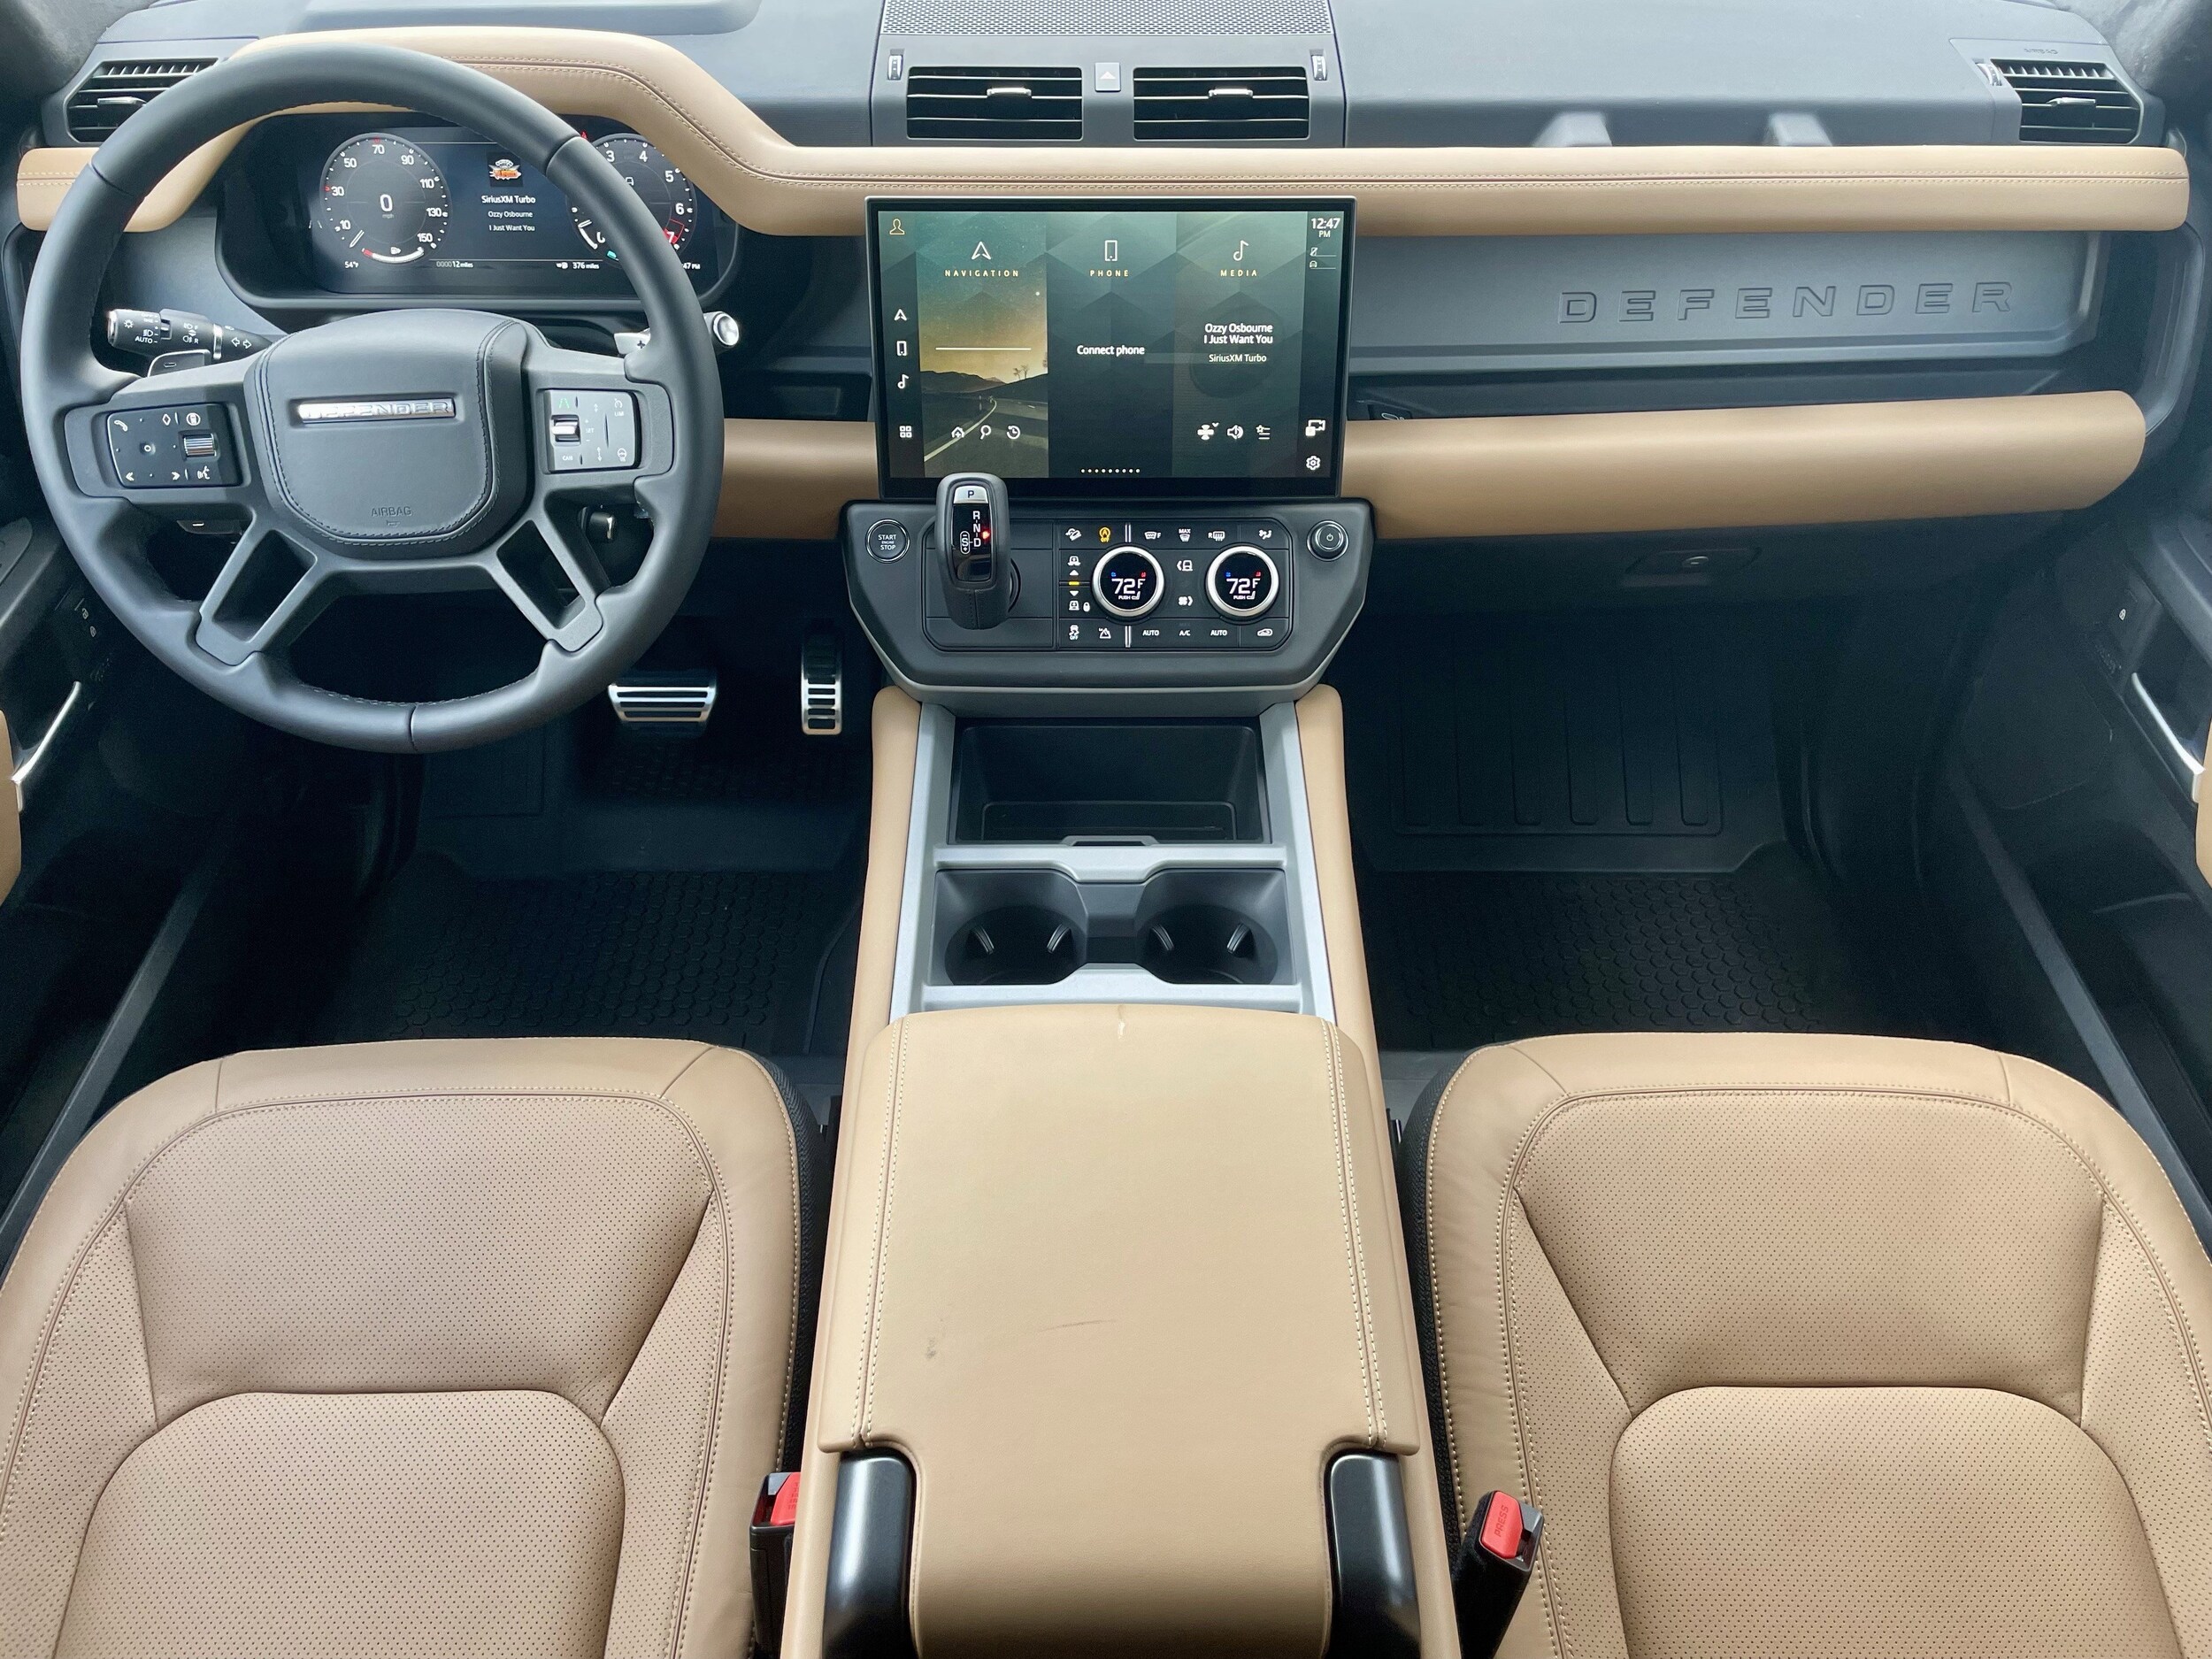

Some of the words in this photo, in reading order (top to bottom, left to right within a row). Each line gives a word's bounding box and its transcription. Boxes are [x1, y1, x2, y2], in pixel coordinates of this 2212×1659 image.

[372, 145, 385, 154] 70
[401, 155, 414, 165] 90
[606, 150, 615, 162] 3
[639, 150, 648, 162] 4
[344, 158, 357, 168] 50
[665, 170, 674, 182] 5
[420, 179, 434, 188] 110
[331, 186, 344, 196] 30
[380, 194, 393, 212] 0
[481, 195, 513, 203] SiriusXM
[515, 195, 536, 204] Turbo
[426, 208, 442, 217] 130
[675, 203, 684, 215] 6
[340, 220, 351, 230] 10
[1311, 218, 1340, 229] 12:47
[417, 233, 433, 242] 150
[667, 232, 675, 243] 7
[1558, 281, 2013, 324] DEFENDER
[1205, 323, 1228, 334] Ozzy
[1229, 323, 1273, 333] Osbourne
[1204, 335, 1207, 344] I
[1209, 335, 1228, 344] Just
[1229, 335, 1254, 344] Want
[1256, 335, 1273, 344] You
[1077, 345, 1114, 354] Connect
[1116, 345, 1145, 357] phone
[1209, 354, 1243, 362] SiriusXM
[1245, 354, 1267, 362] Turbo
[307, 401, 449, 419] EFENDER
[967, 490, 974, 498] P
[371, 506, 412, 517] AIRBAG
[973, 511, 980, 520] R
[973, 524, 980, 532] N
[961, 538, 969, 546] S
[974, 538, 982, 547] D
[1494, 1505, 1509, 1537] PRESS
